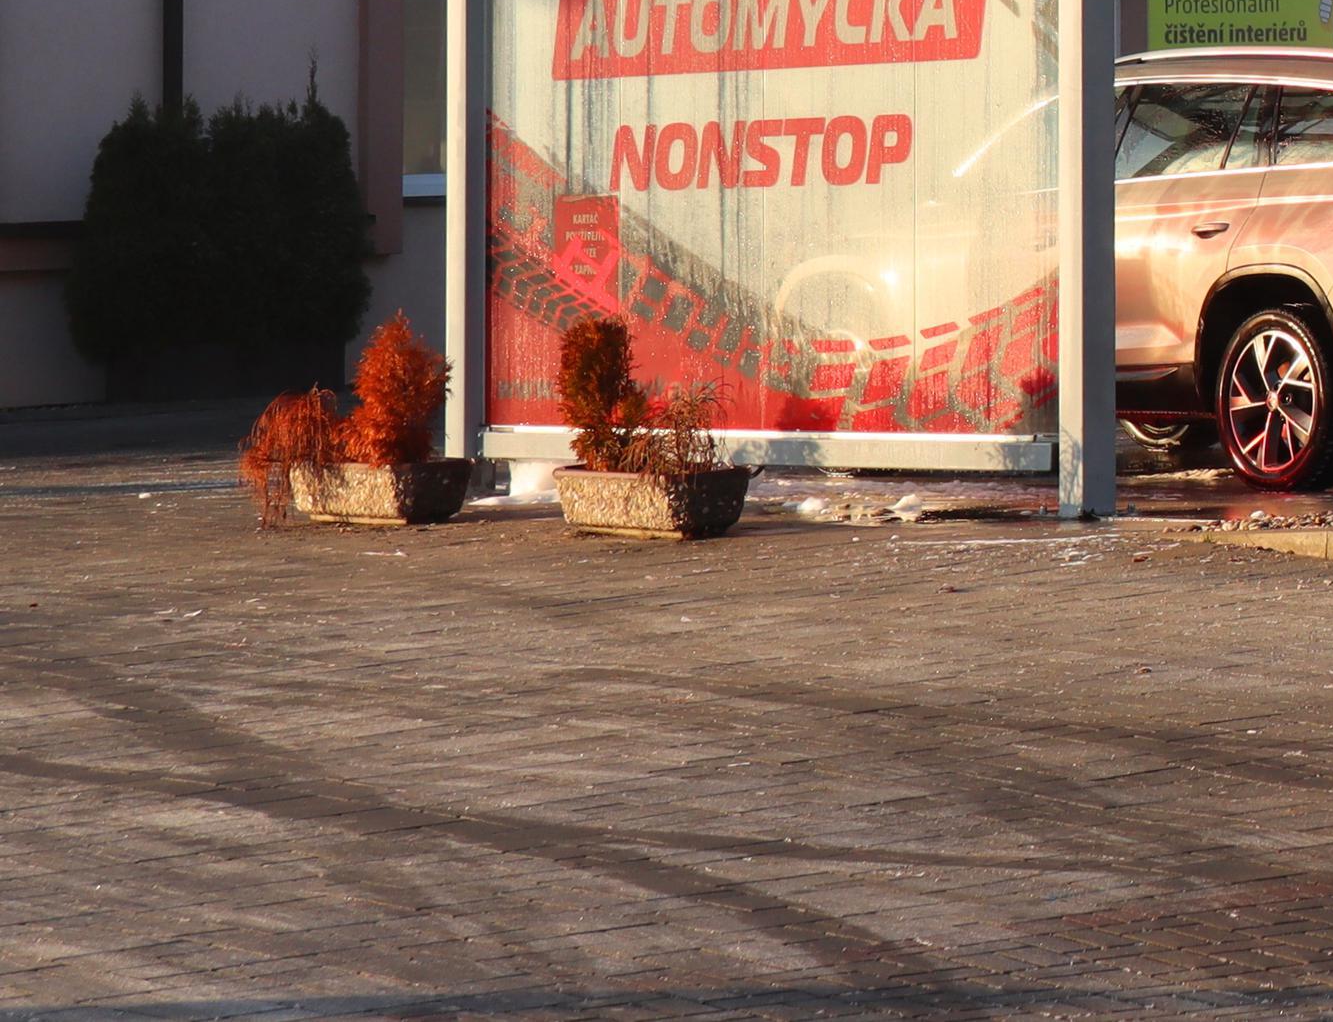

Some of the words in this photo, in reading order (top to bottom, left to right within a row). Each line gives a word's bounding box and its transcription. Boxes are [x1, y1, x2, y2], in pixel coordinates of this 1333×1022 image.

[1164, 23, 1225, 44] čištění
[1229, 21, 1307, 42] interiérů
[609, 113, 913, 192] NONSTOP
